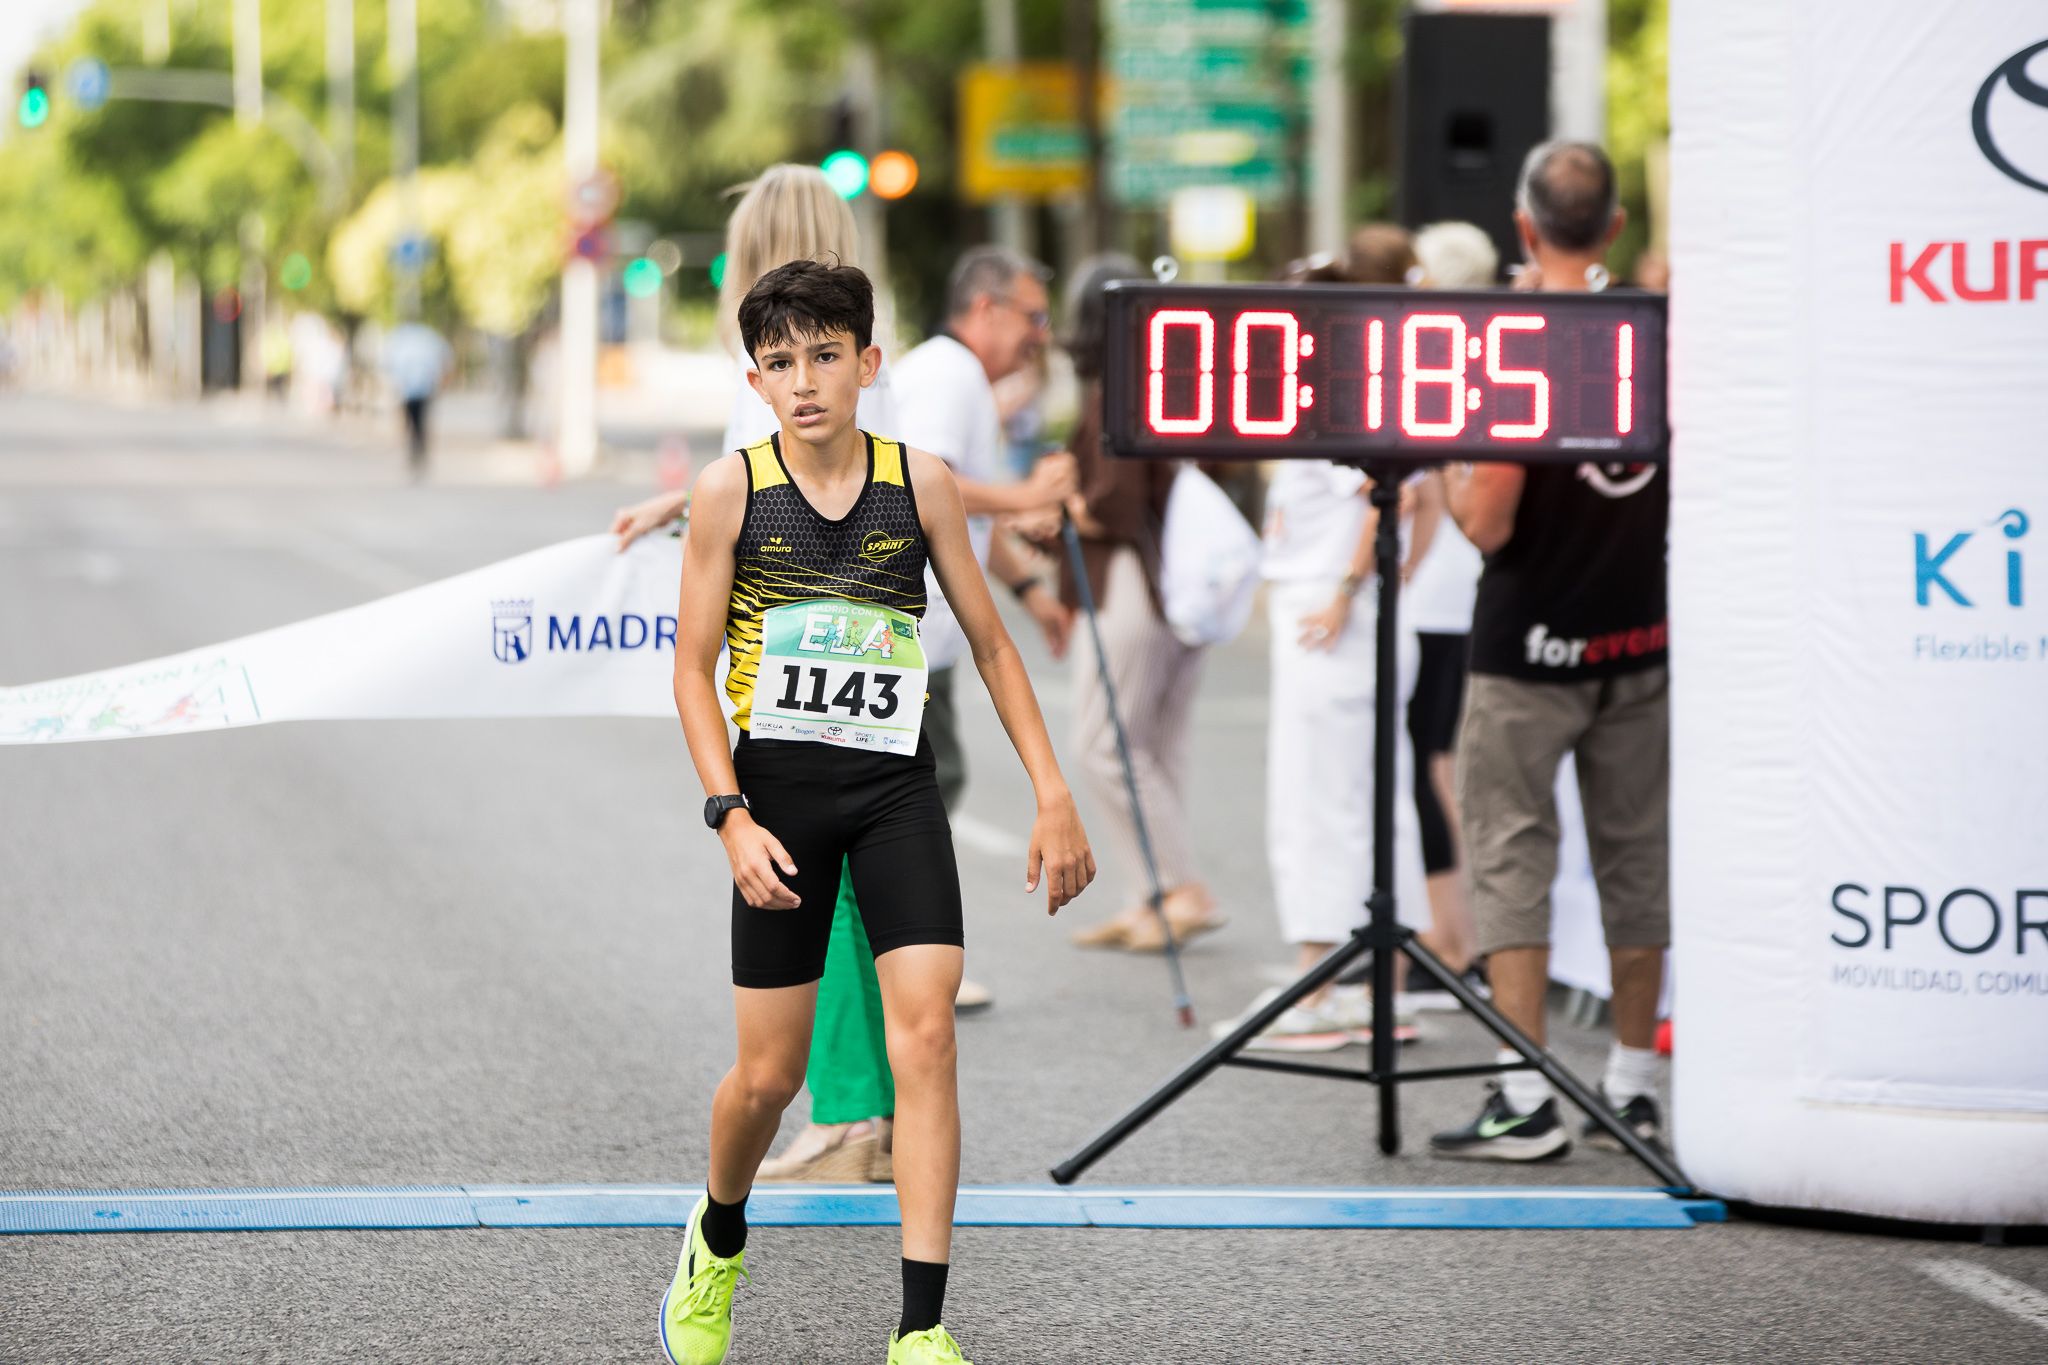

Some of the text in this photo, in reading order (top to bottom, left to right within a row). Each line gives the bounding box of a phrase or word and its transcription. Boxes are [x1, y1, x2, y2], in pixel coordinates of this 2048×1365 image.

[760, 545, 792, 553] amura
[808, 604, 849, 615] MADRID
[851, 607, 872, 617] CON
[797, 613, 893, 659] ELA
[1914, 634, 2029, 661] Flexible
[776, 664, 902, 720] 1143
[1831, 883, 2048, 955] SPOR
[1833, 964, 1969, 995] MOVILIDAD,
